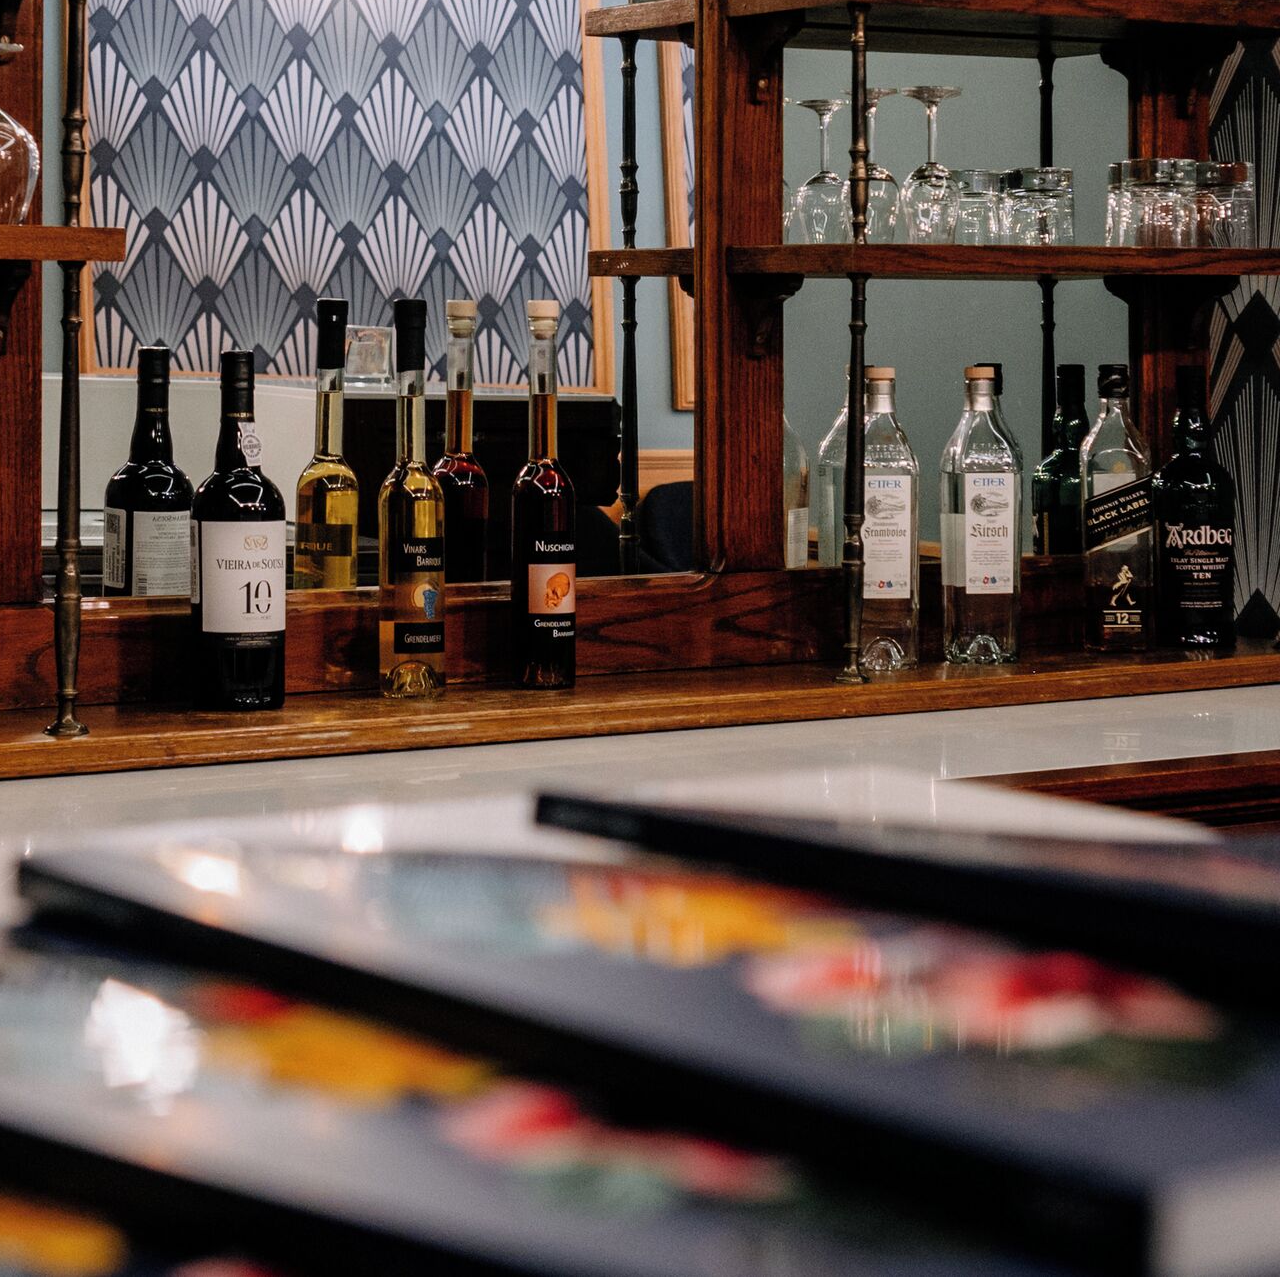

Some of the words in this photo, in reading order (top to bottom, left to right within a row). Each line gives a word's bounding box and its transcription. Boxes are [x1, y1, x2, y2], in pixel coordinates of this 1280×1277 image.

[1087, 510, 1118, 526] BLACK
[1120, 498, 1150, 514] LABEL
[864, 527, 907, 539] Framboise
[970, 523, 1008, 538] Kirsch
[403, 543, 426, 554] VINARS
[216, 558, 251, 570] VIEIRA
[239, 580, 272, 614] 10
[1116, 613, 1129, 624] 12
